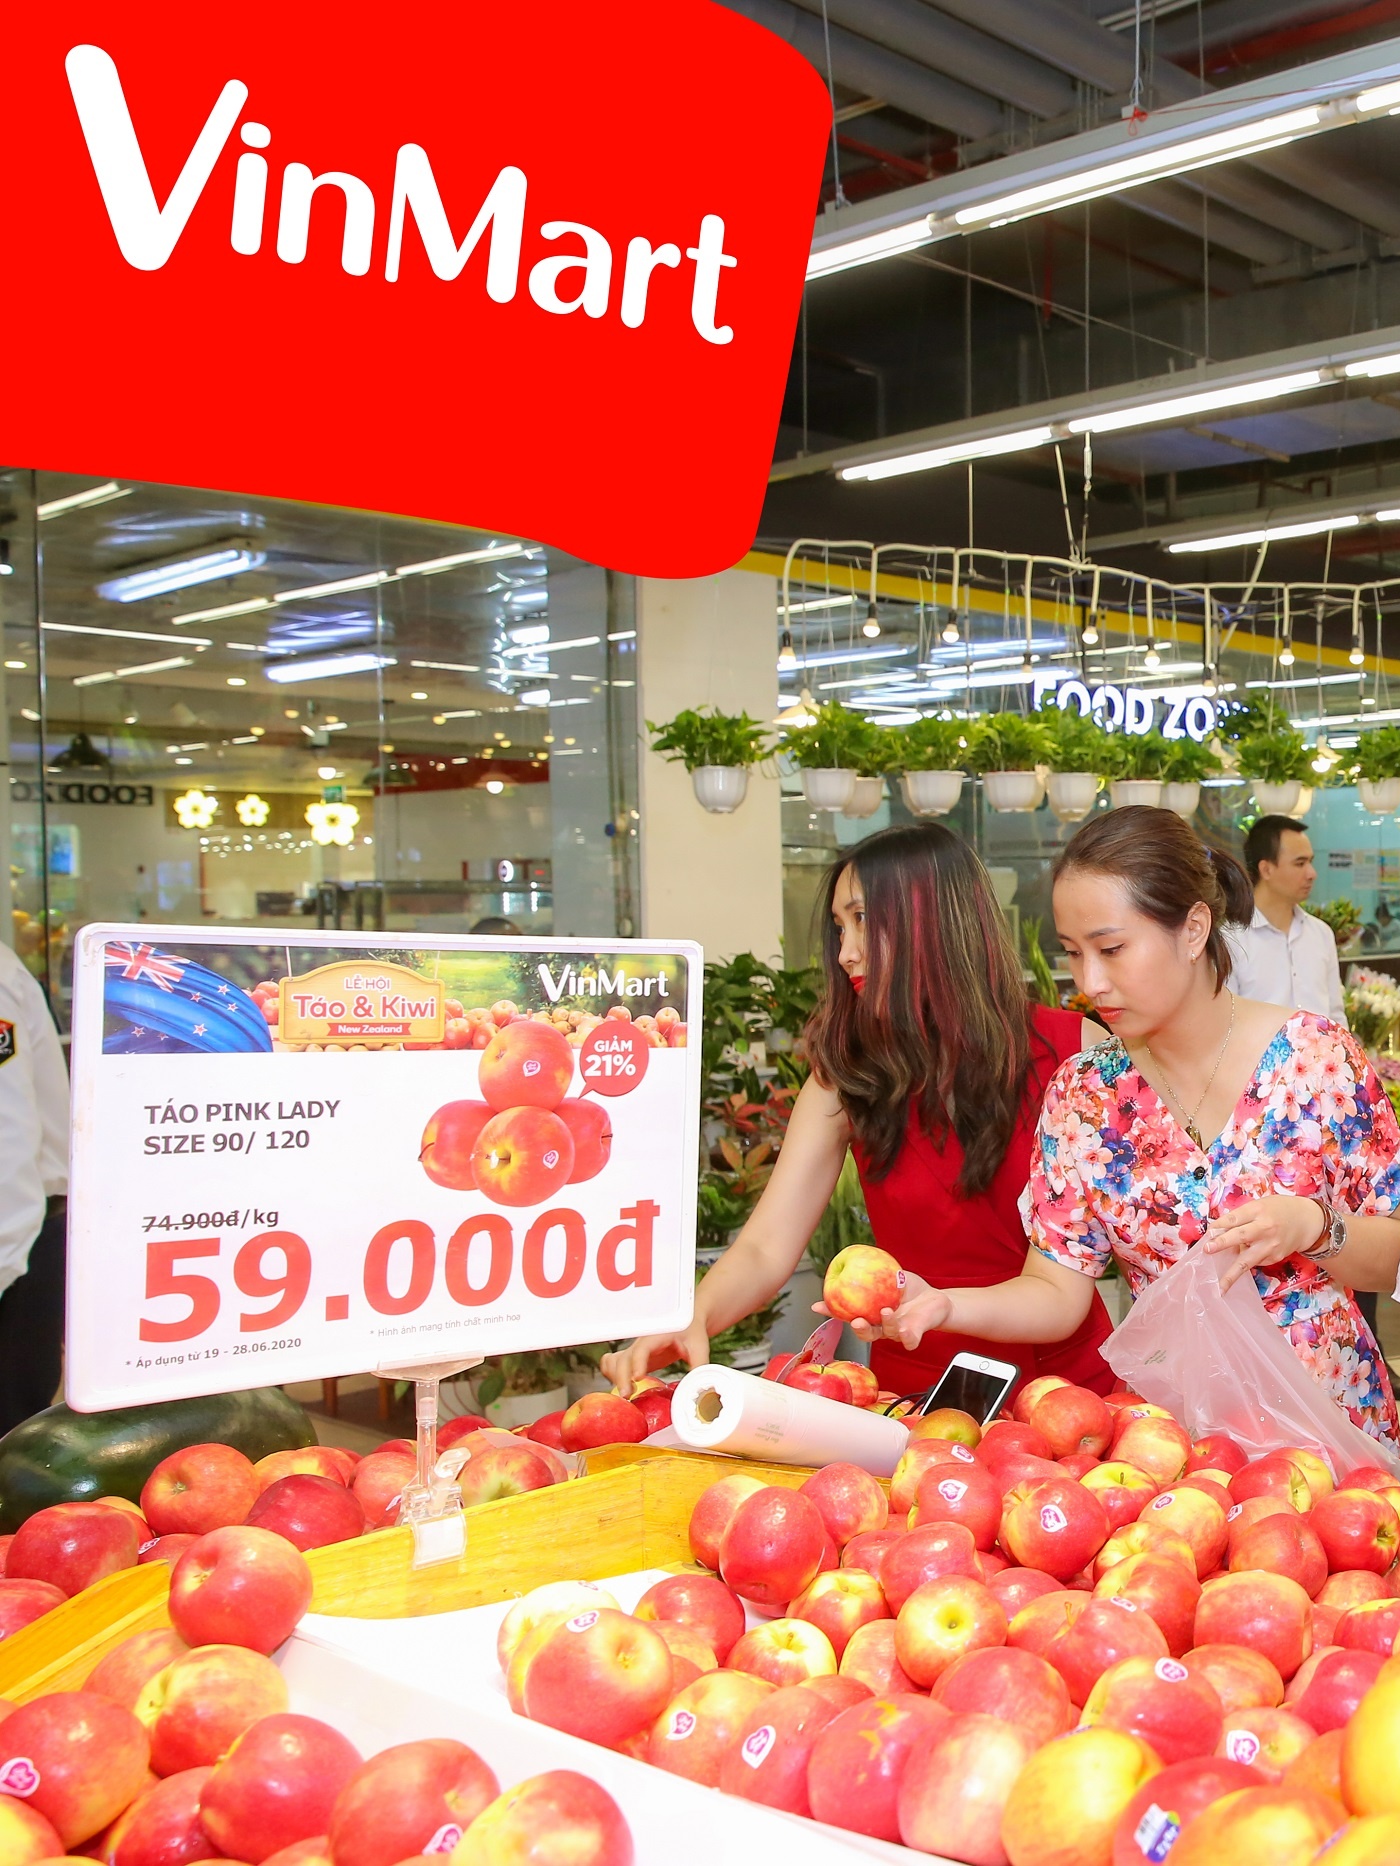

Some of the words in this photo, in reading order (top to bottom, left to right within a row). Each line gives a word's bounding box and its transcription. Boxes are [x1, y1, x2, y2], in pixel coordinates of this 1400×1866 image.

[538, 963, 669, 1002] VinMart
[293, 996, 346, 1018] Táo
[353, 996, 374, 1018] &
[382, 996, 435, 1018] Kiwi
[338, 1025, 361, 1034] New
[362, 1024, 403, 1034] Zealand
[594, 1035, 633, 1053] GIẢM
[584, 1054, 637, 1077] 21%
[144, 1098, 199, 1125] TÁO
[206, 1102, 271, 1122] PINK
[277, 1100, 341, 1120] LADY
[143, 1134, 205, 1156] SIZE
[212, 1131, 256, 1155] 90/
[265, 1130, 310, 1150] 120
[138, 1199, 661, 1343] 59.000đ
[419, 1323, 443, 1332] mang
[484, 1315, 503, 1324] minh
[204, 1348, 219, 1359] 19
[233, 1338, 302, 1355] 28.06.2020
